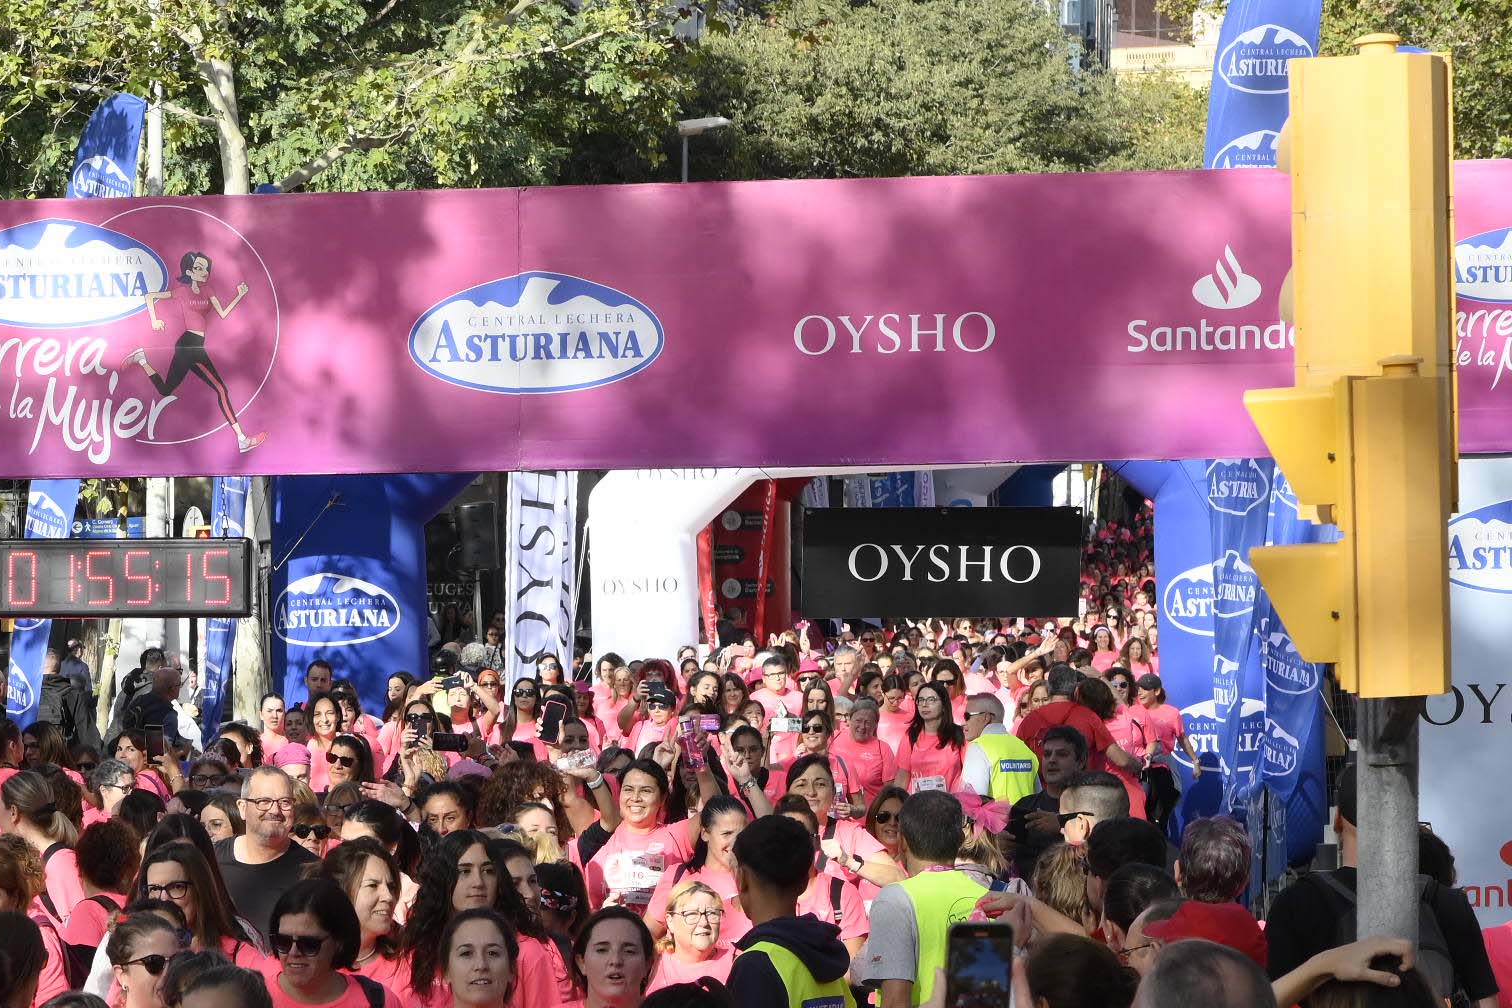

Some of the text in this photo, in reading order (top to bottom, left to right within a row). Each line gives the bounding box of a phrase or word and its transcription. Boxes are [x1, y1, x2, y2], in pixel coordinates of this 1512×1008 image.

[469, 313, 635, 327] CENTRAL LECHERA
[793, 311, 996, 355] OYSHO
[429, 319, 644, 363] ASTURIANA
[9, 379, 33, 419] la
[29, 371, 179, 465] Mujer
[848, 543, 1041, 584] OYSHO
[290, 598, 386, 607] CENTRAL LECHERA
[603, 576, 679, 595] OYSHO
[278, 603, 391, 630] ASTURIANA
